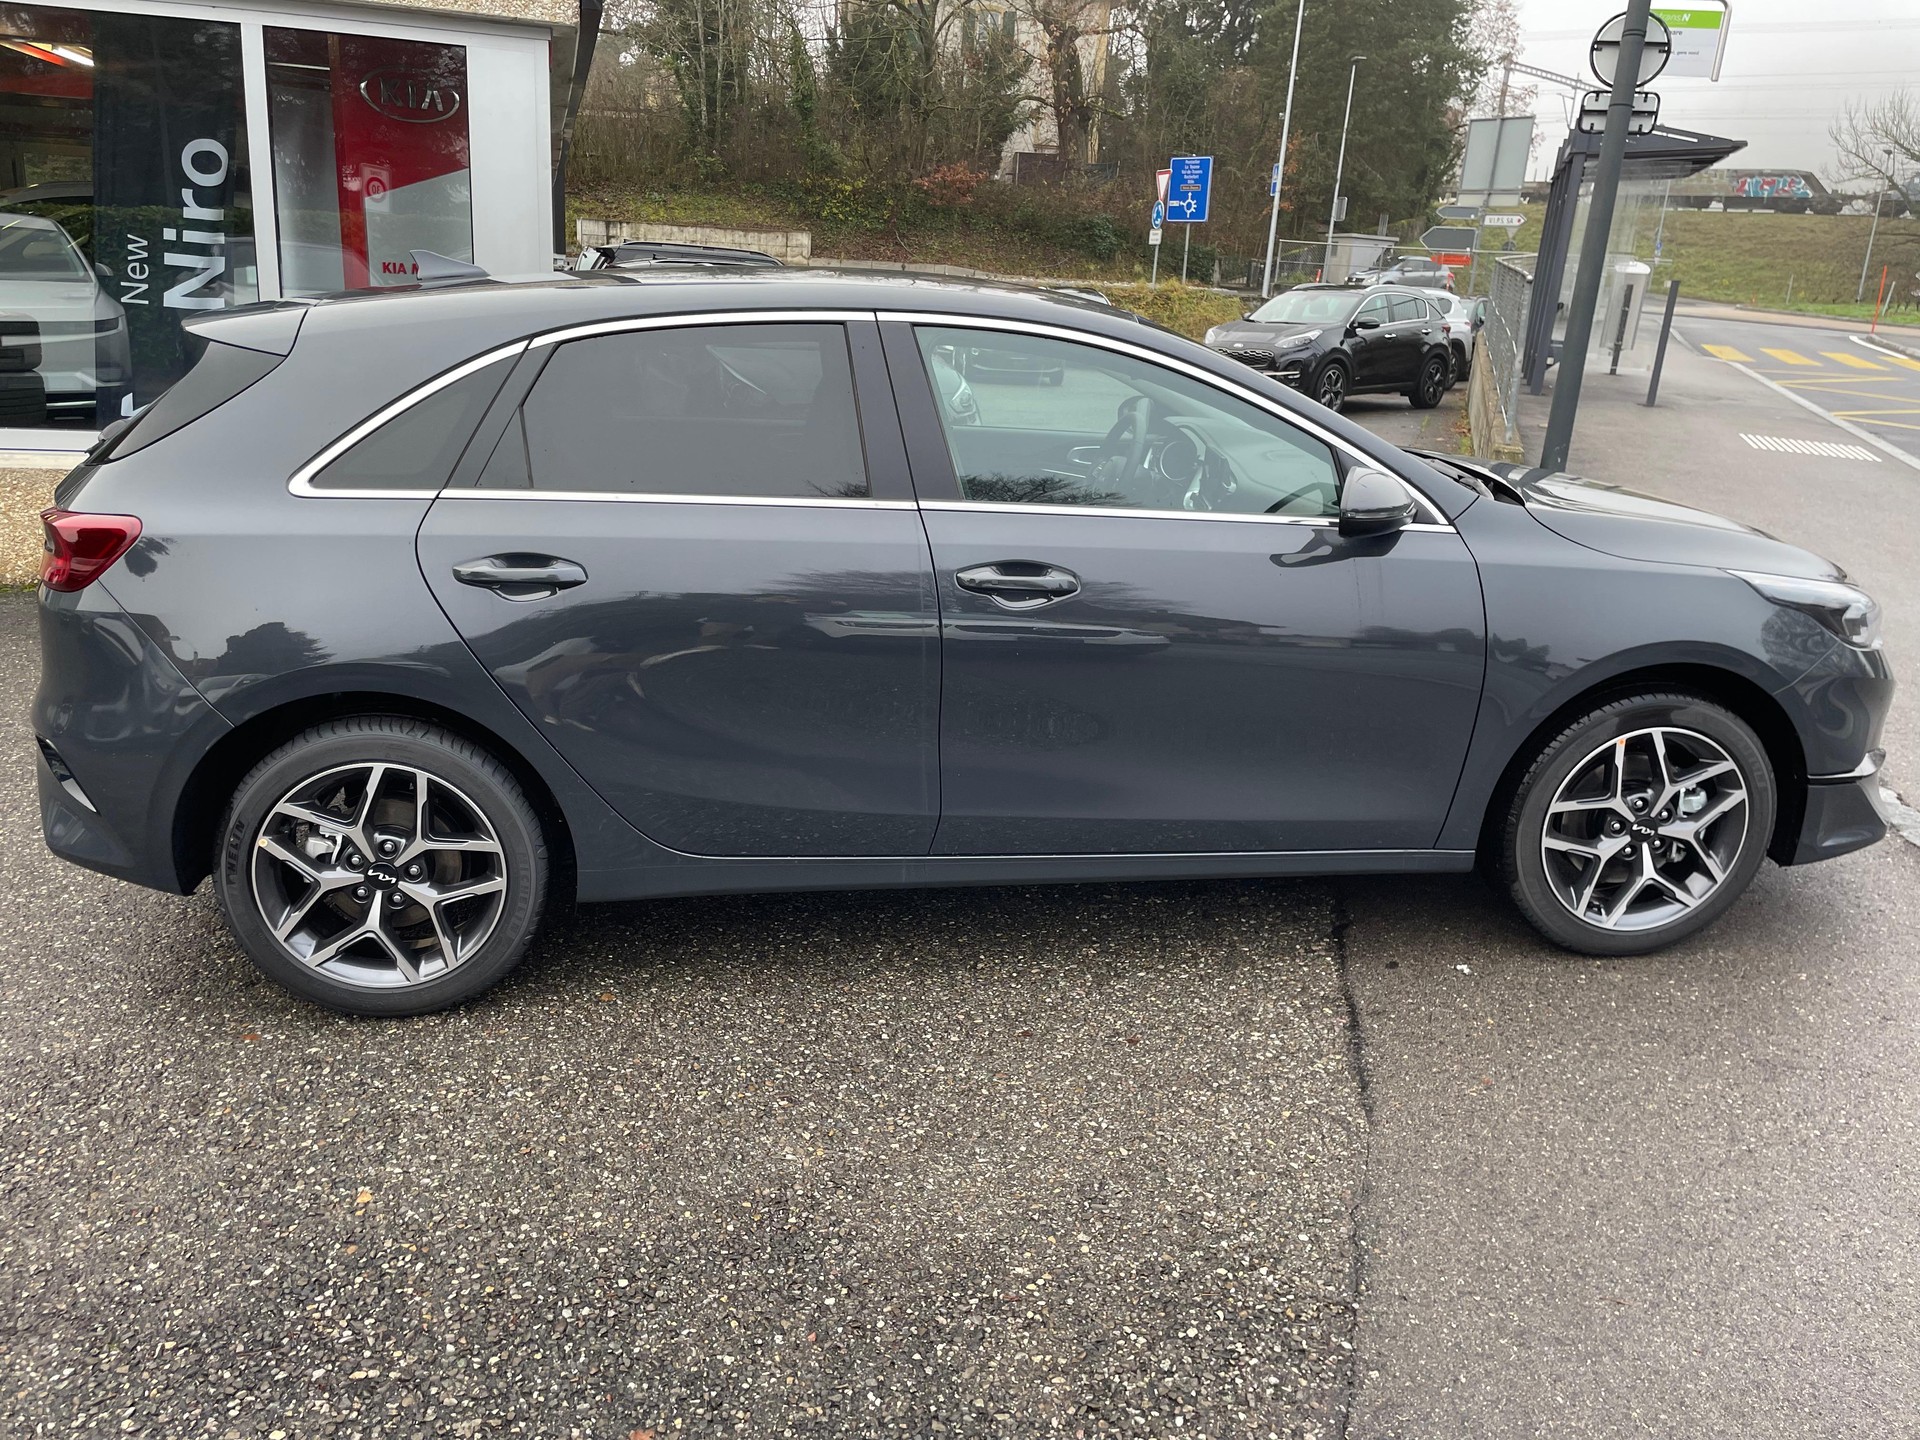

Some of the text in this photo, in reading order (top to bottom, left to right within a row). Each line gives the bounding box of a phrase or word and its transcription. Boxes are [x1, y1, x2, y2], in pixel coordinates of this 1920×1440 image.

[379, 78, 443, 112] KIA
[163, 138, 228, 309] Niro
[120, 234, 149, 305] New
[382, 262, 407, 275] KIA
